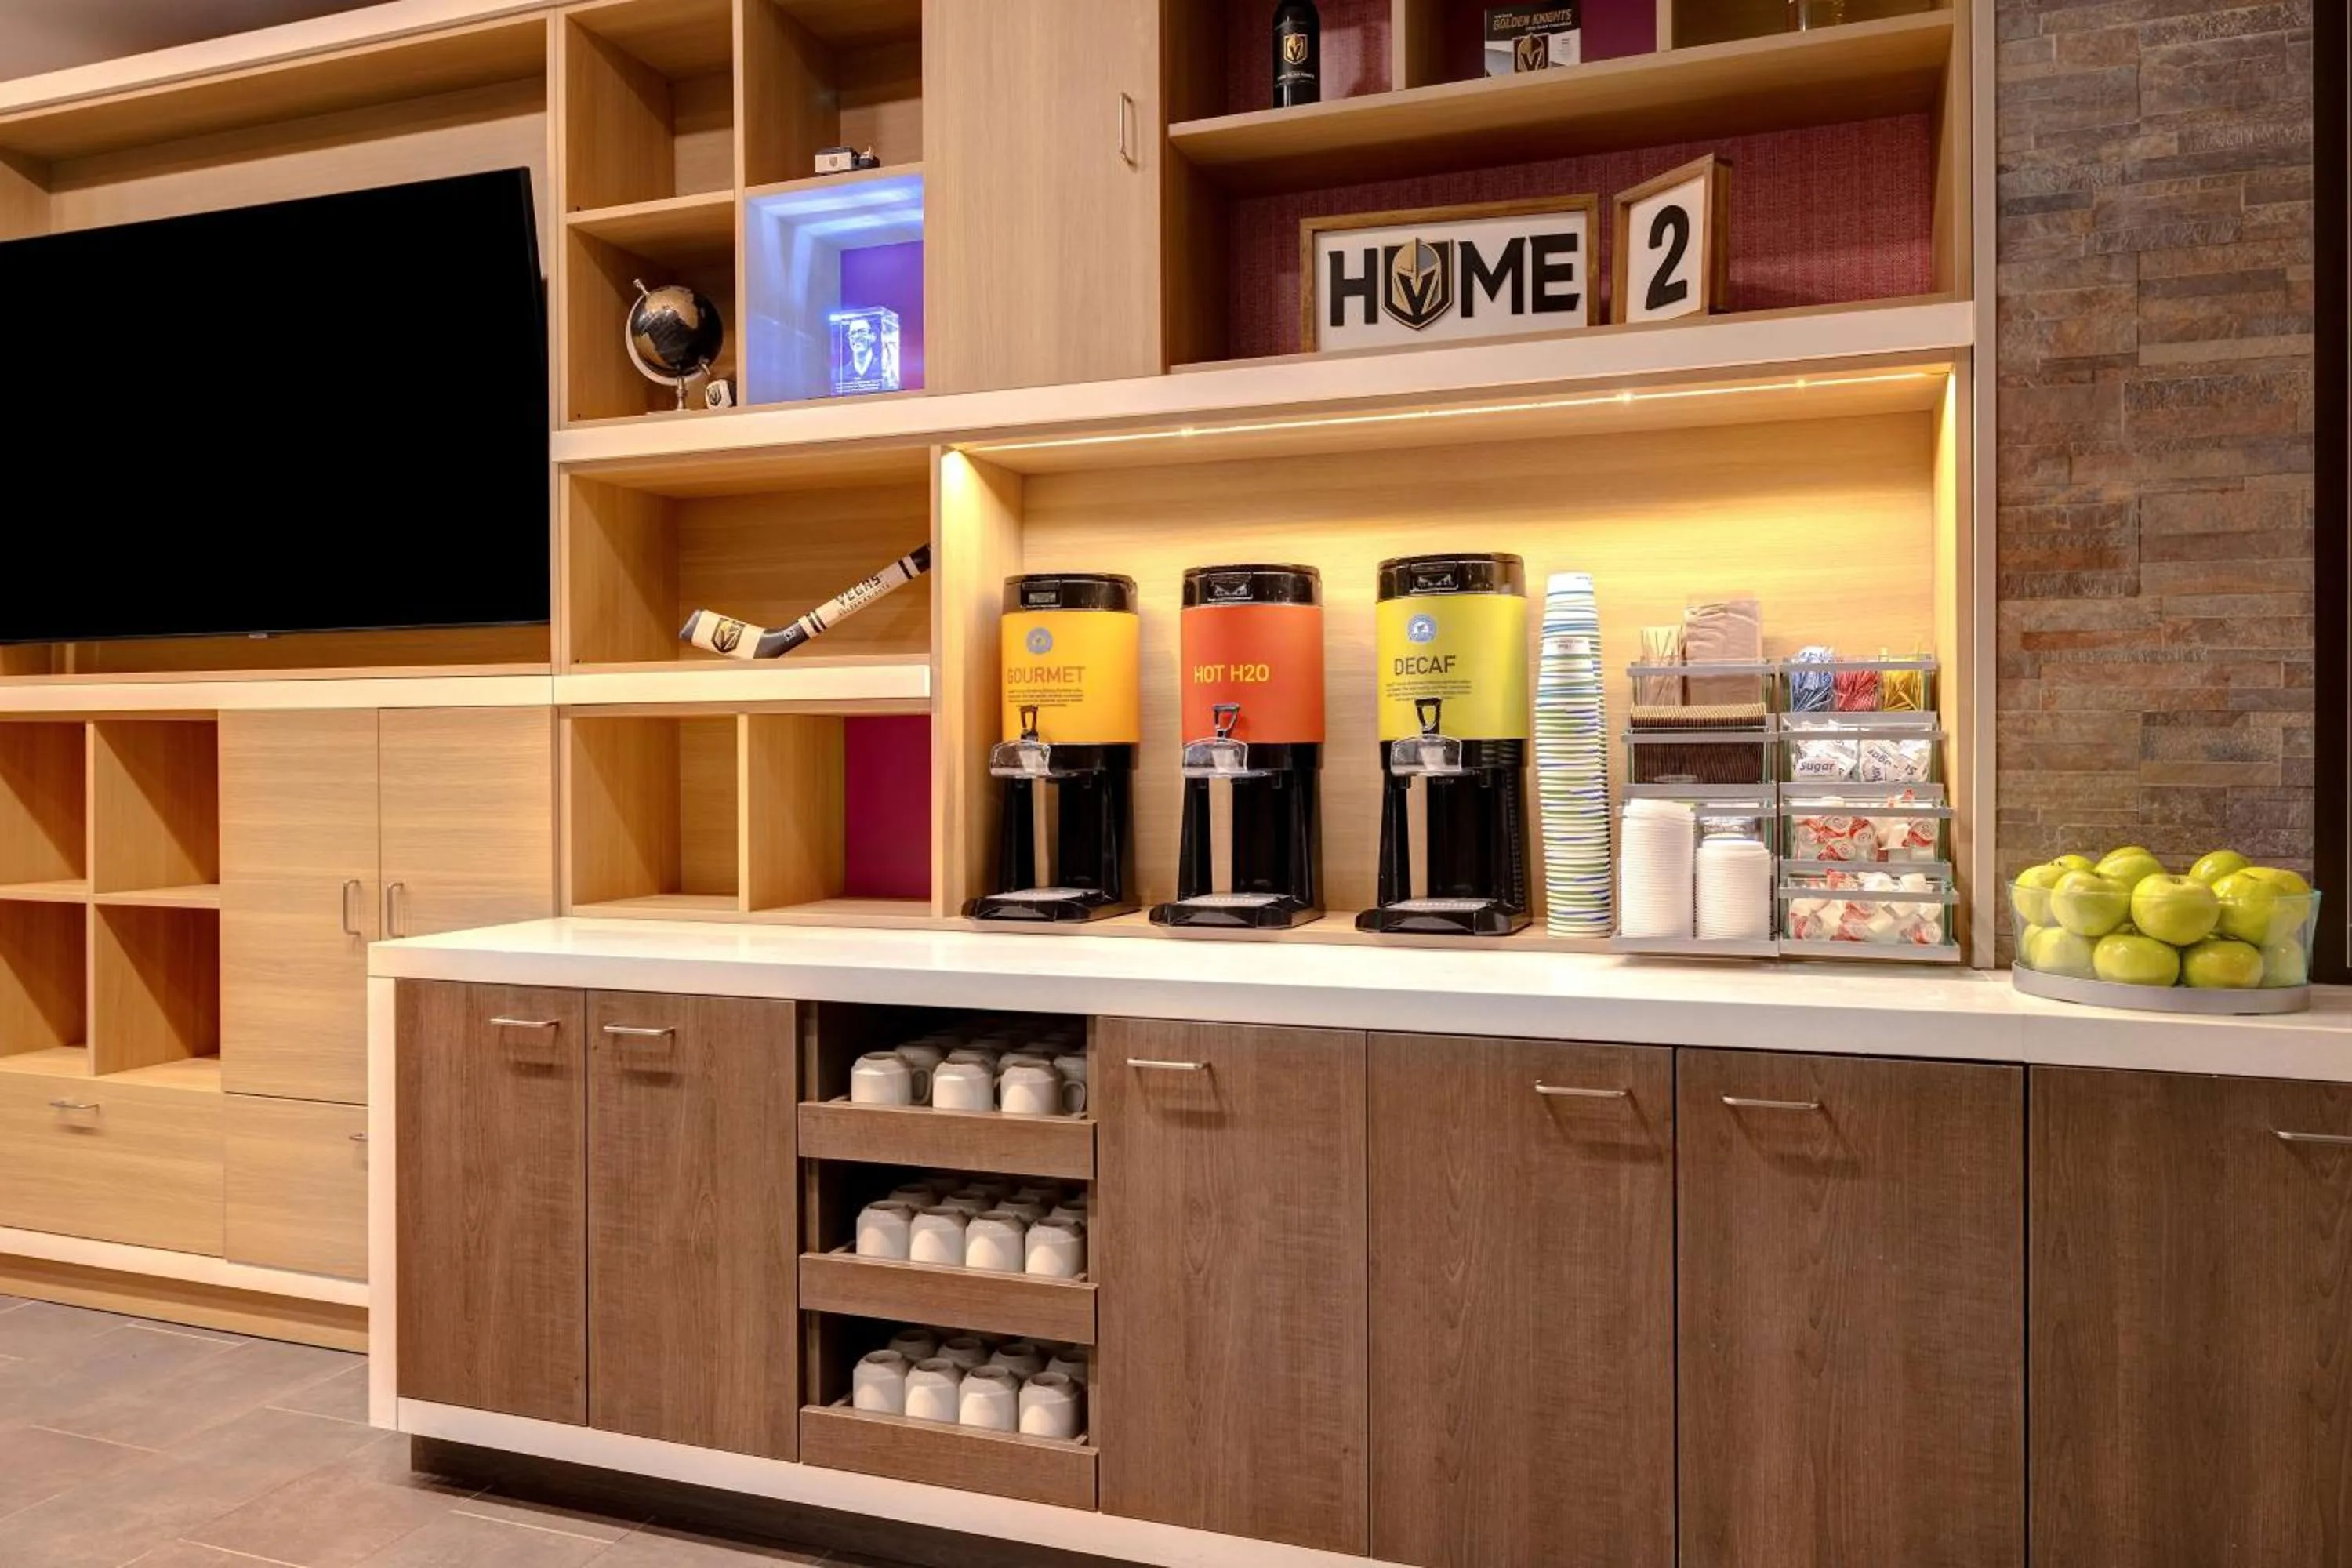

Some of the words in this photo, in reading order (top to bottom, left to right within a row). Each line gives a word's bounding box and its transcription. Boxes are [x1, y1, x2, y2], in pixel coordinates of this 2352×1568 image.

[1532, 9, 1573, 25] KNIGHTS
[1646, 205, 1690, 310] 2
[1007, 666, 1086, 684] GOURMET
[1193, 664, 1225, 684] HOT
[1394, 655, 1456, 676] DECAF
[1800, 761, 1835, 773] sugar
